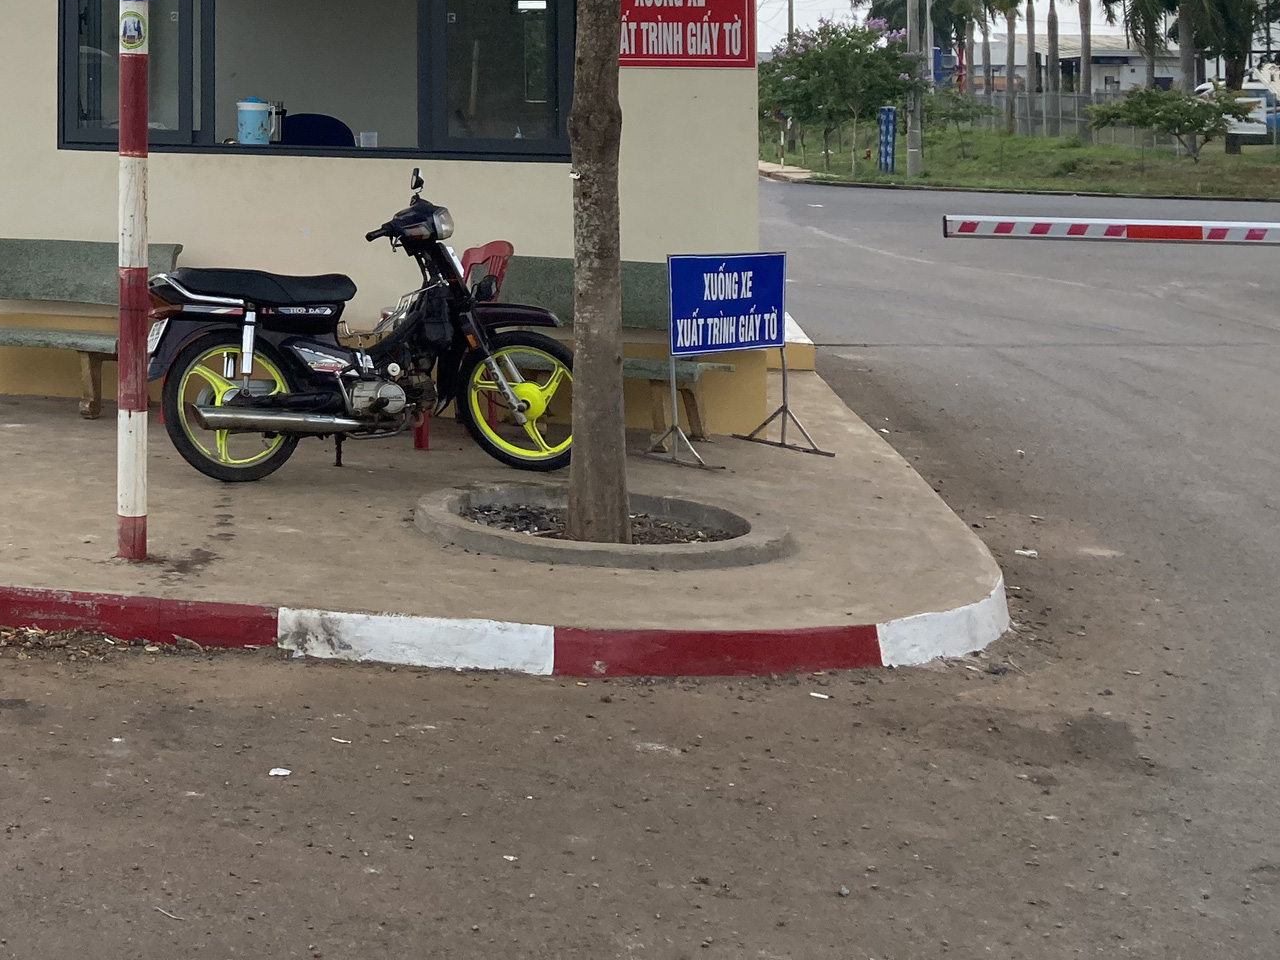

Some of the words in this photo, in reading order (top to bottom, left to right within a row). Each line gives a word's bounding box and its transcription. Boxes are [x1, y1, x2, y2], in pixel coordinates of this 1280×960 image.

[620, 10, 637, 54] ẤT
[640, 15, 683, 55] TRÌNH
[687, 10, 720, 56] GIẤY
[723, 14, 742, 56] TỜ
[703, 262, 738, 301] XUỐNG
[740, 271, 753, 298] XE
[676, 308, 705, 348] XUẤT
[707, 310, 736, 345] TRÌNH
[739, 304, 761, 343] GIẤY
[764, 306, 778, 340] TỜ
